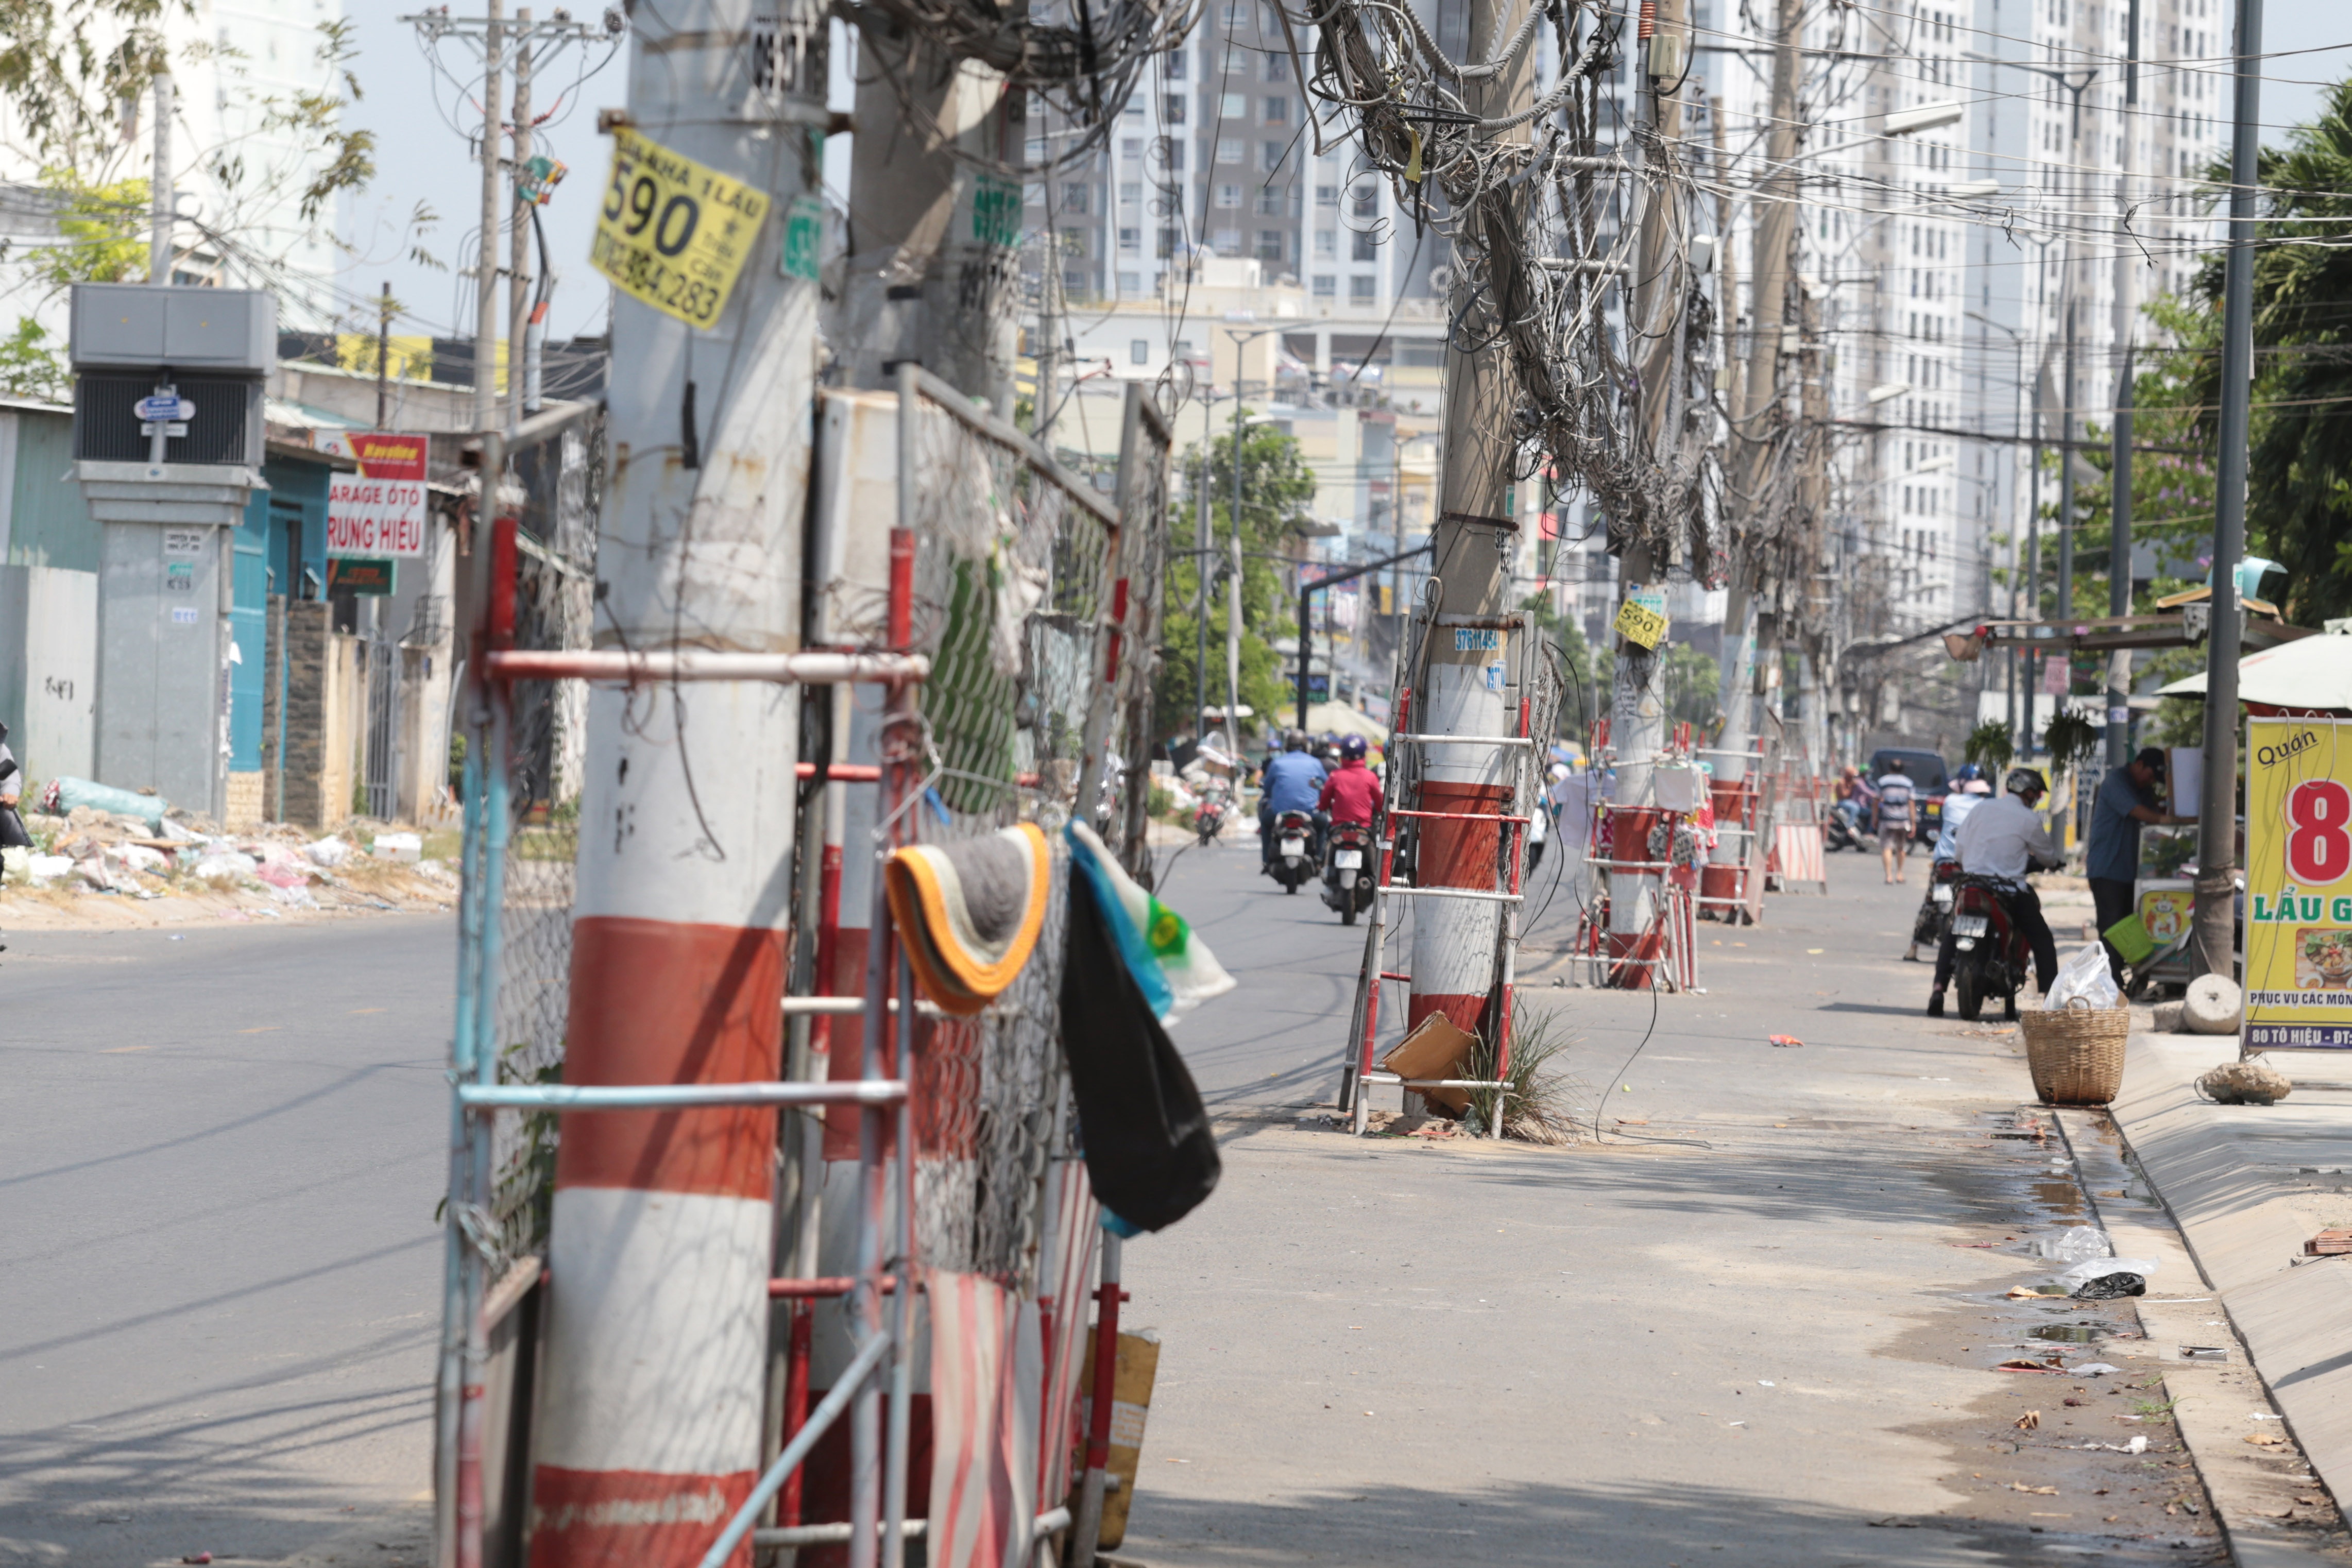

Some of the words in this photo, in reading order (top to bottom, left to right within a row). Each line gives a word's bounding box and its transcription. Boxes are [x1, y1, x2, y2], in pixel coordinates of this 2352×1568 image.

[604, 160, 698, 257] 590
[329, 486, 382, 504] ARAGE
[328, 517, 373, 549] RUNG
[1621, 608, 1654, 632] 590
[1456, 629, 1497, 650] 37611454
[2258, 731, 2317, 765] Quán
[2254, 887, 2322, 921] LẨU
[2251, 993, 2280, 1006] PHỤC
[2284, 993, 2298, 1007] VỤ
[2302, 992, 2323, 1004] CÁC
[2252, 1029, 2269, 1043] 80
[2290, 1028, 2322, 1047] HIỆU
